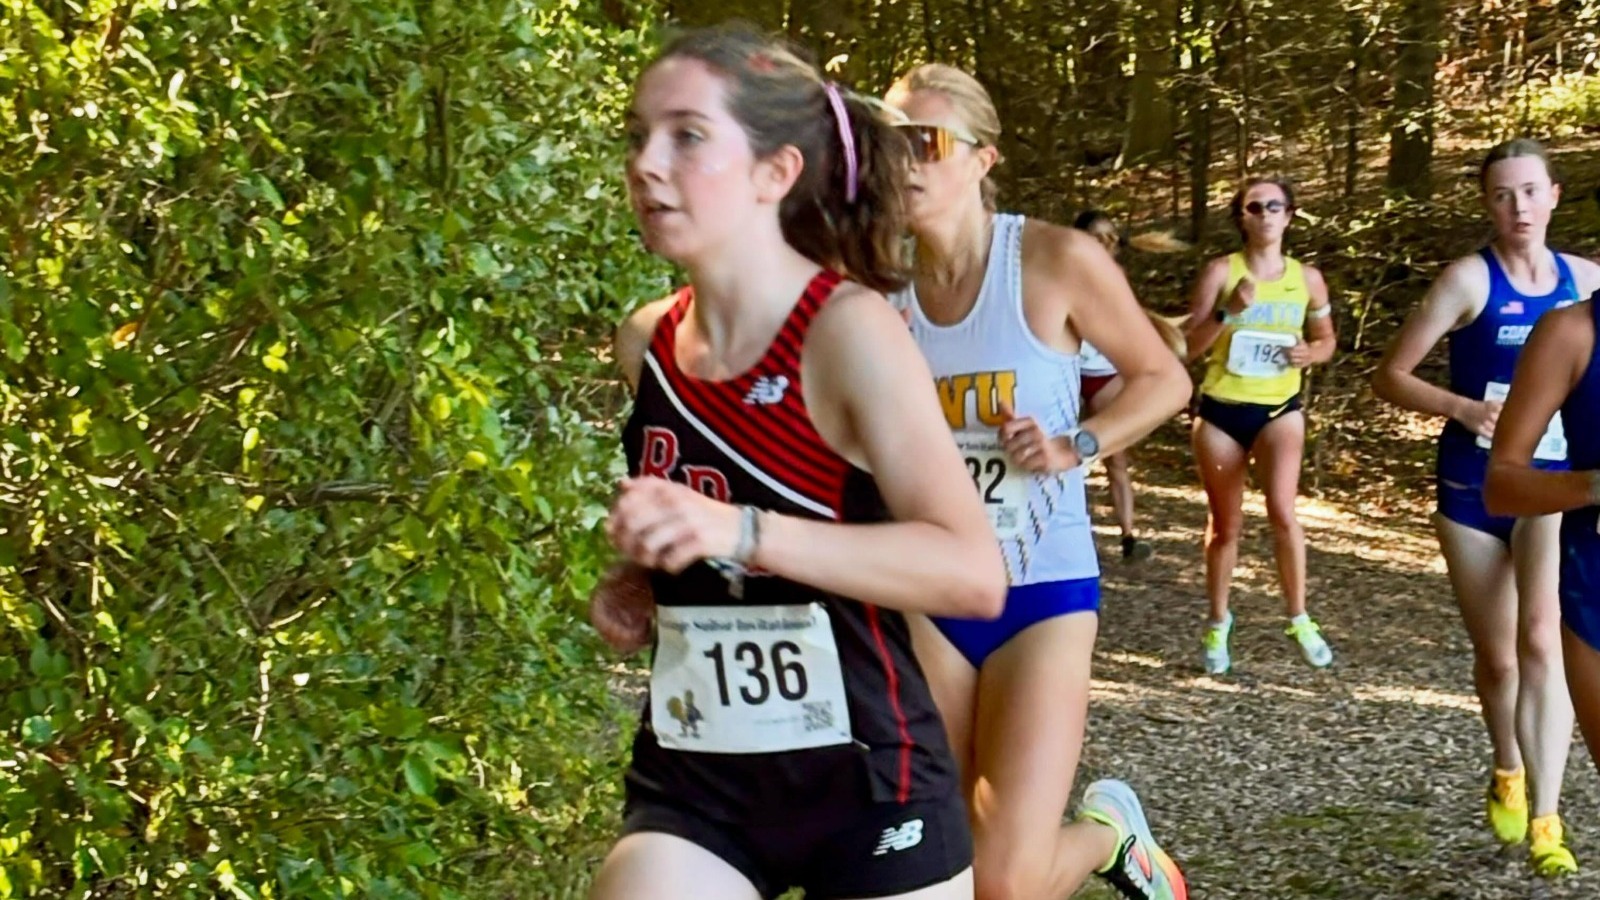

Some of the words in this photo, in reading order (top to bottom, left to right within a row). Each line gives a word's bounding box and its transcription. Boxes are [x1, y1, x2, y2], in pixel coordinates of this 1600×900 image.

[1253, 344, 1282, 364] 192
[639, 425, 732, 503] RP
[703, 641, 809, 707] 136
